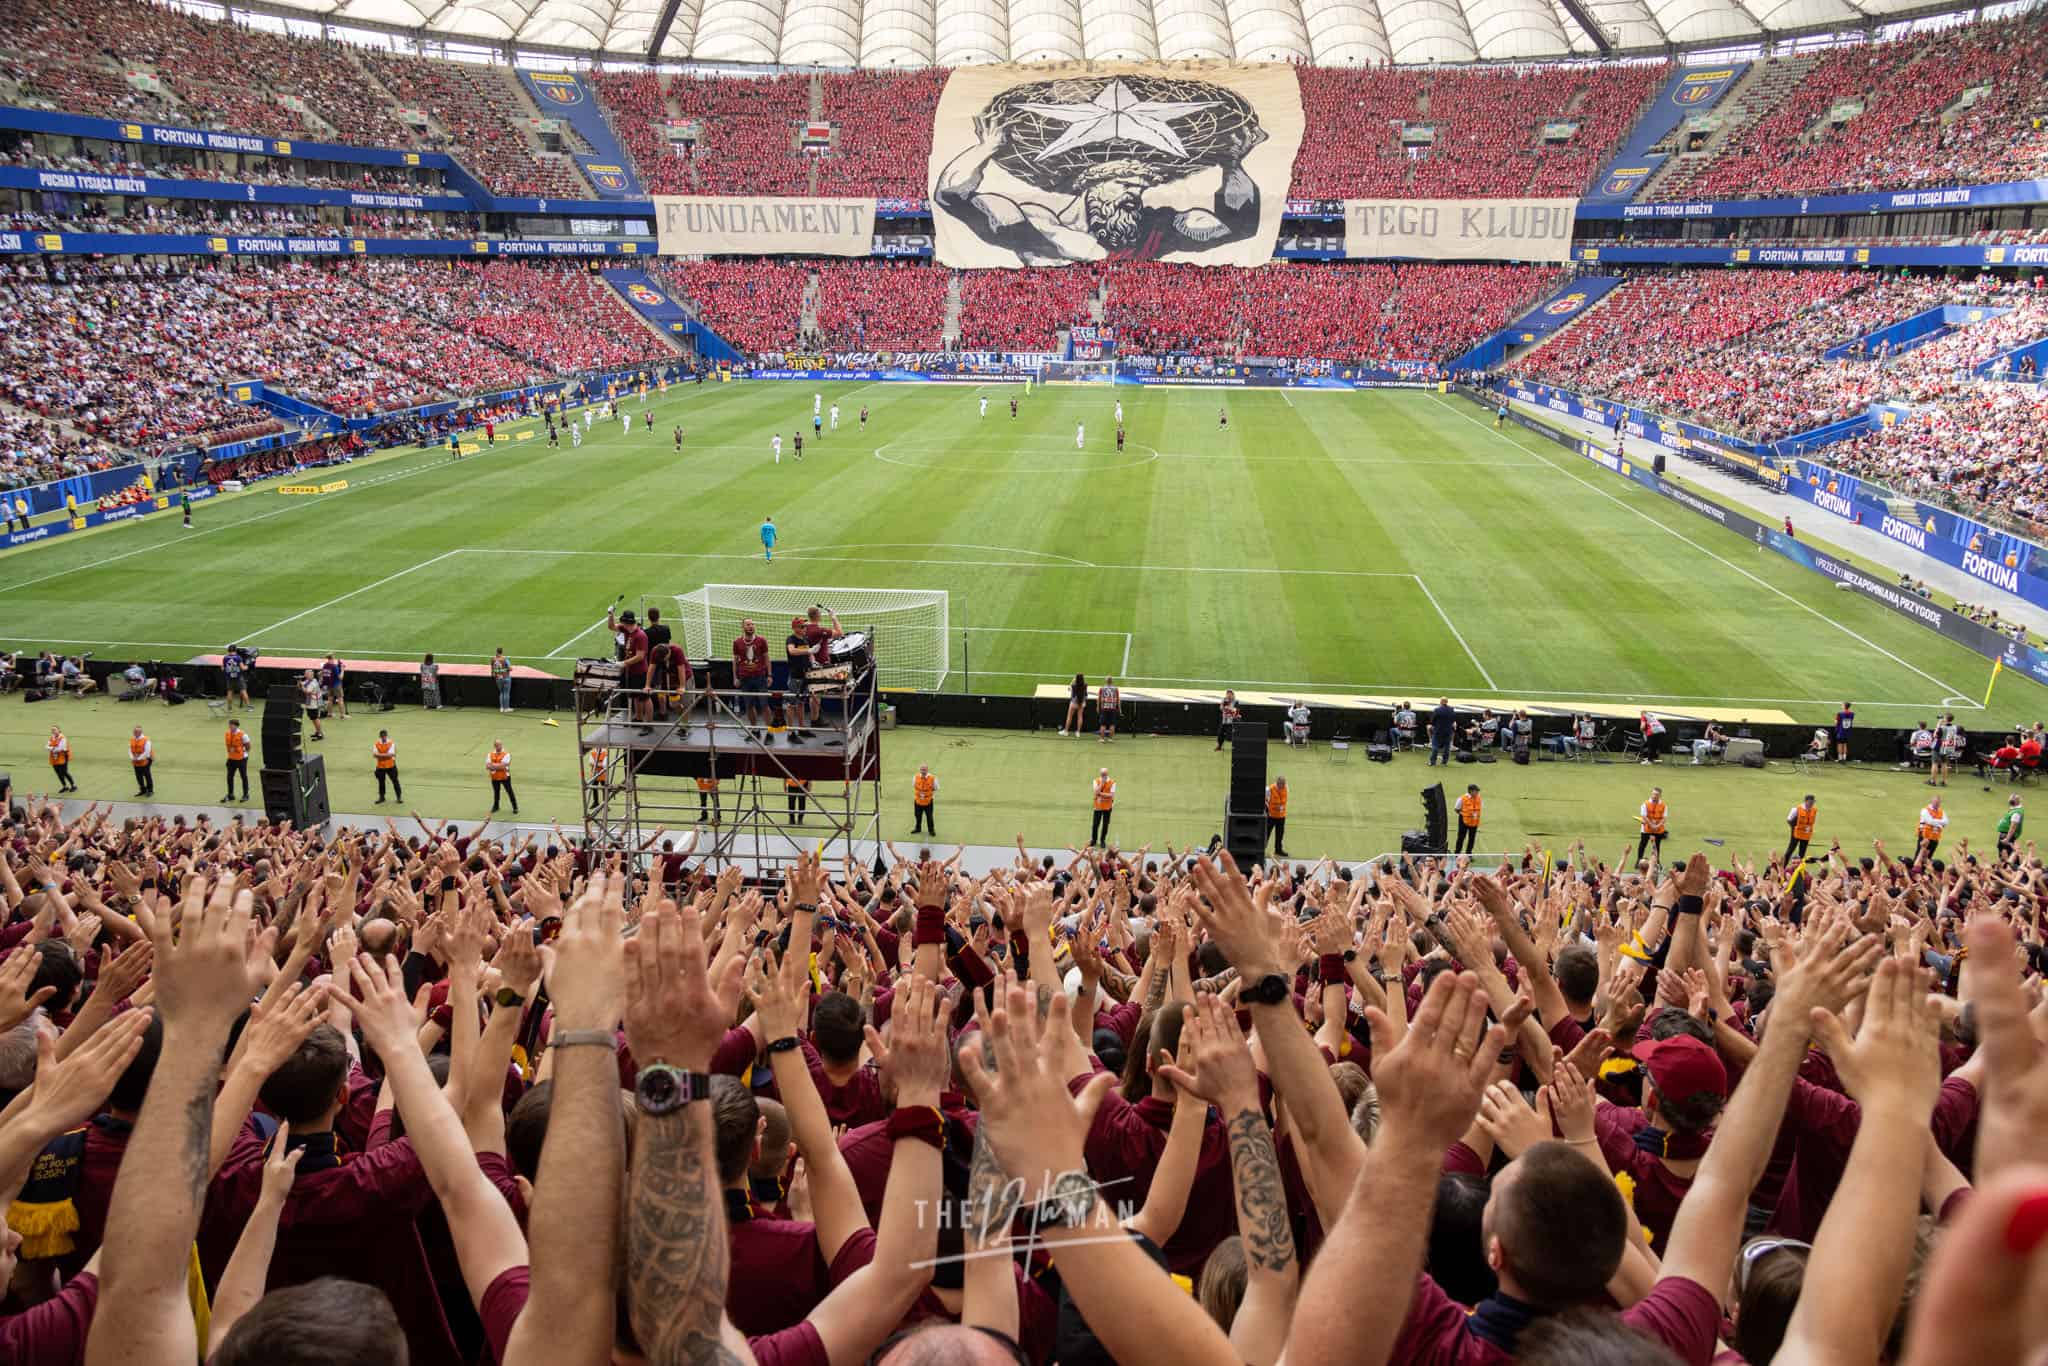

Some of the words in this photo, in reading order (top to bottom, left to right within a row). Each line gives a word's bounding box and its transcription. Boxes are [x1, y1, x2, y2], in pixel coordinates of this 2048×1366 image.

[153, 128, 205, 146] FORTUNA
[208, 134, 237, 149] PUCHAR
[40, 173, 75, 188] PUCHAR
[664, 203, 864, 235] FUNDAMENT
[1354, 206, 1439, 237] TEGO
[1458, 206, 1570, 239] KLUBU
[1624, 206, 1653, 216] PUCHAR
[238, 239, 285, 251] FORTUNA
[499, 242, 544, 252] FORTUNA
[579, 243, 606, 253] POLSKI
[1759, 250, 1798, 261] FORTUNA
[1814, 488, 1851, 517] FORTUNA
[1881, 516, 1925, 550] FORTUNA
[1962, 550, 2018, 593] FORTUNA
[1843, 569, 1899, 608] NIEZAPOMNIANĄ
[1900, 597, 1942, 628] PRZYGODĘ
